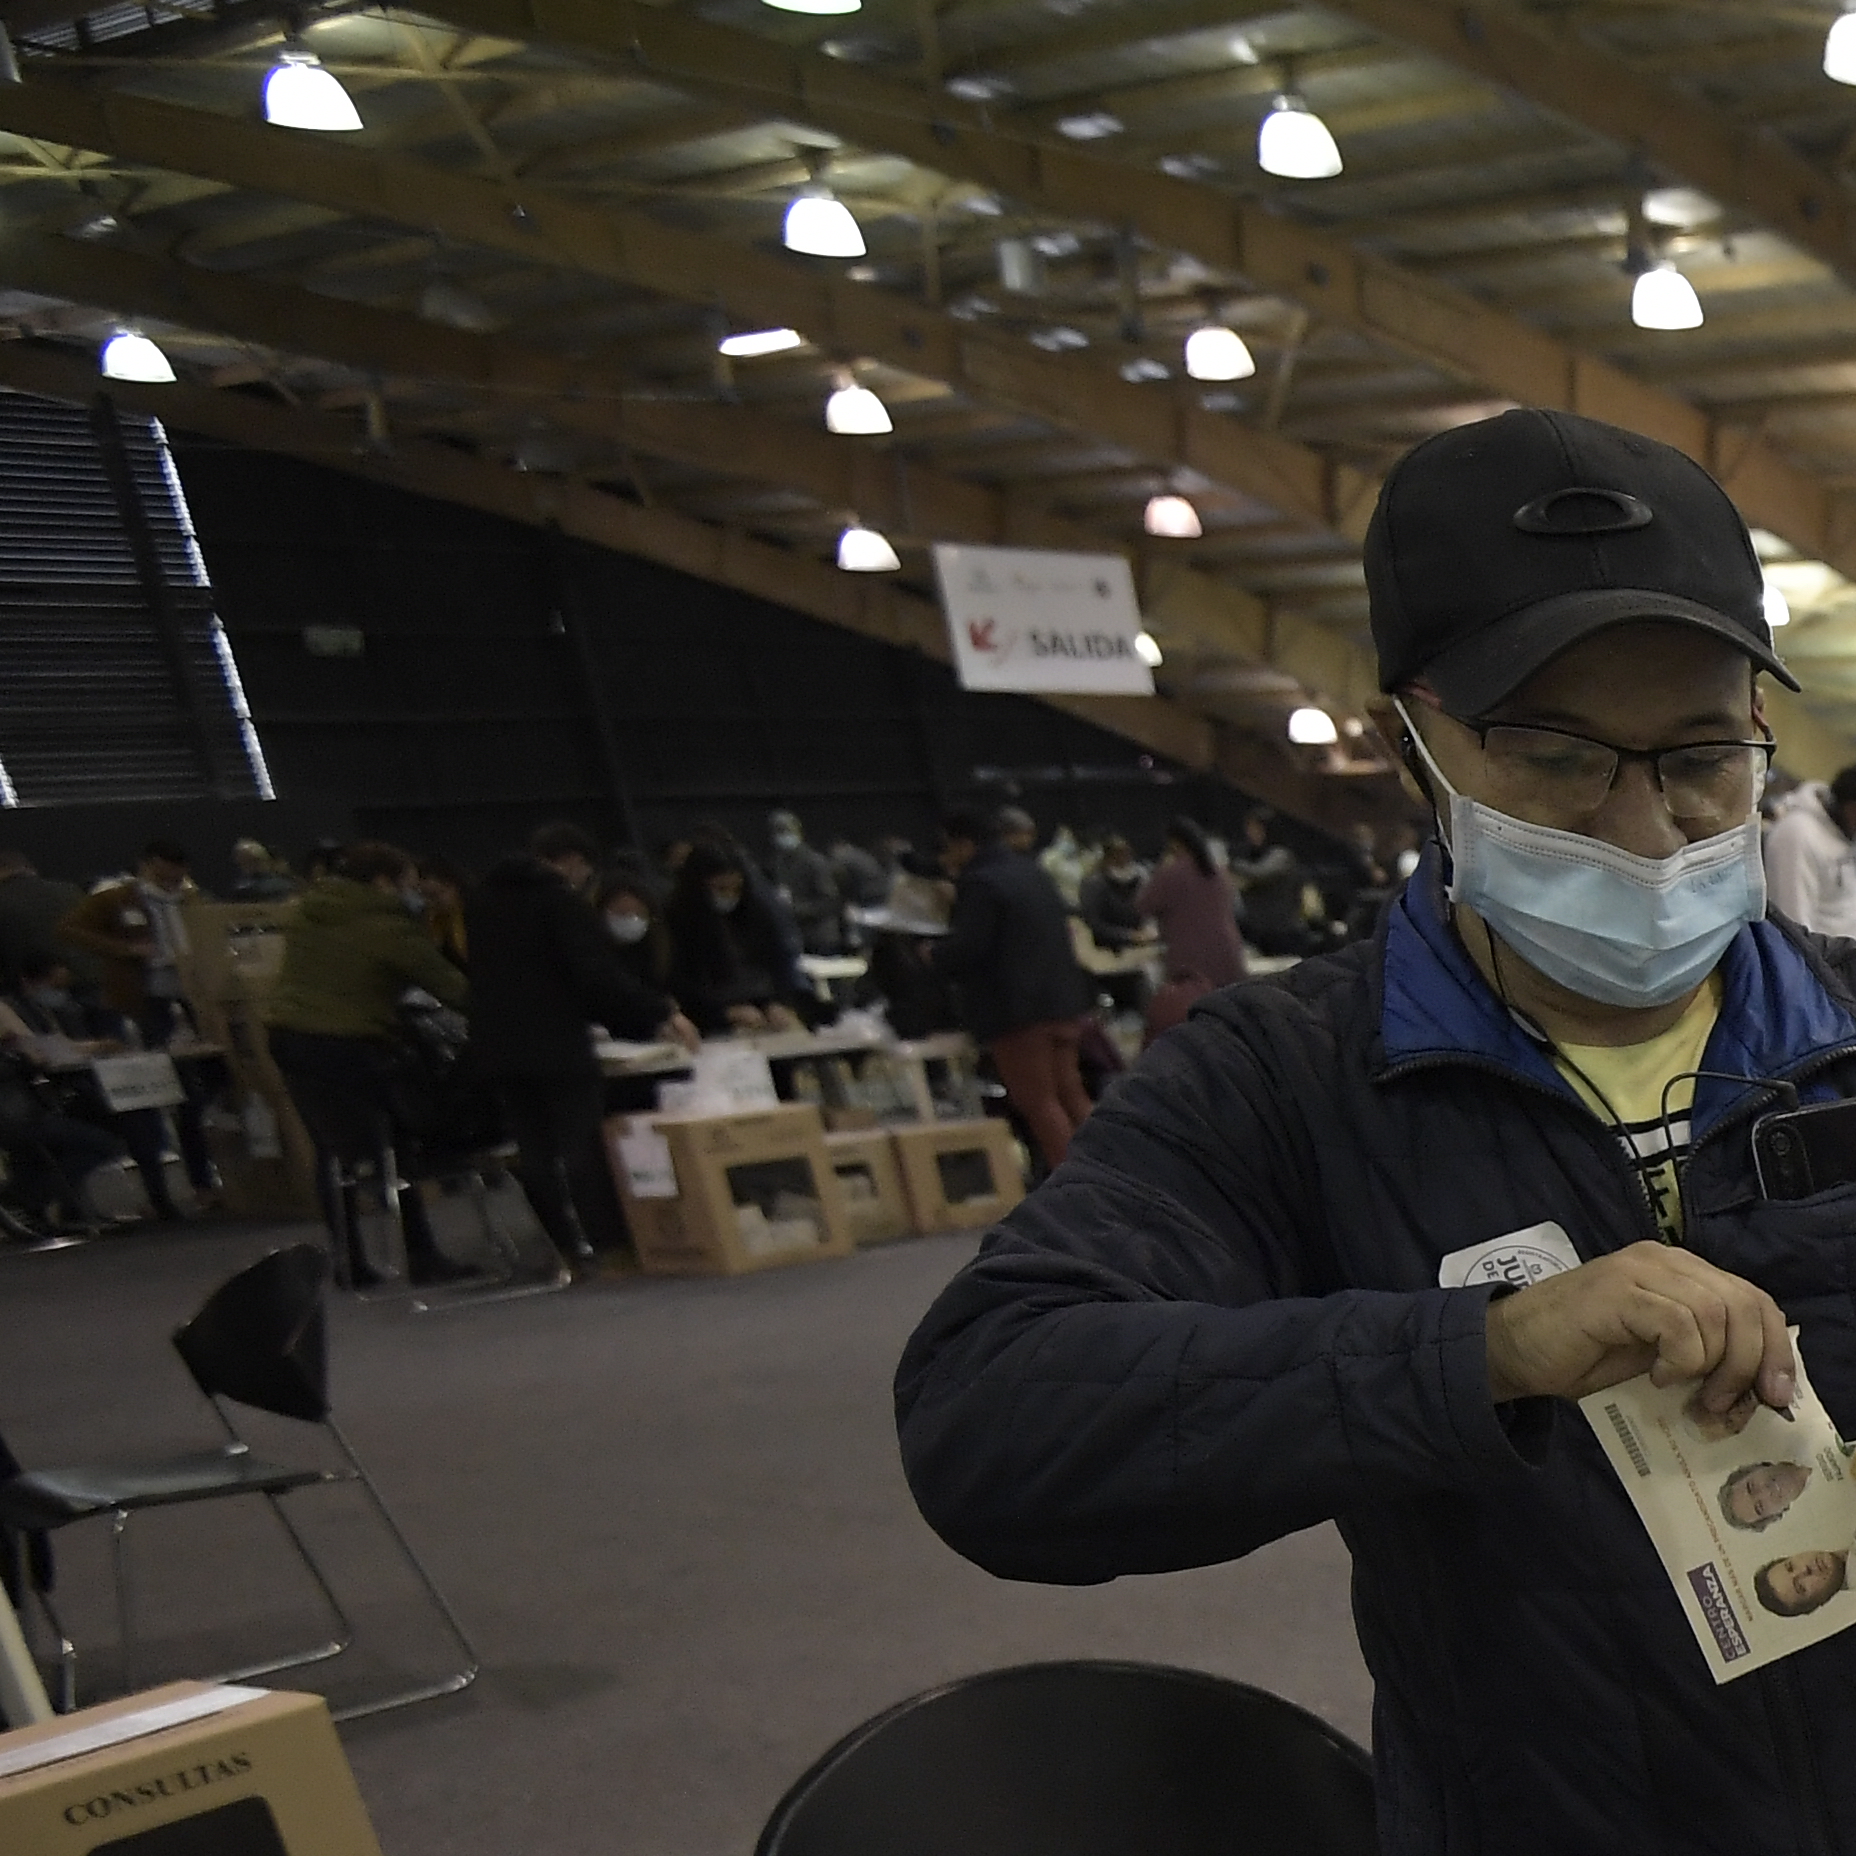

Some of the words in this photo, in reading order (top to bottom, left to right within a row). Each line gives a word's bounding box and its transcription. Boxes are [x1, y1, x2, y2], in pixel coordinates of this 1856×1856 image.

[1029, 630, 1133, 659] SALIDA
[1700, 1564, 1747, 1657] ESPERANZA
[1700, 1593, 1736, 1662] CENTRO
[64, 1752, 253, 1826] CONSULTAS
